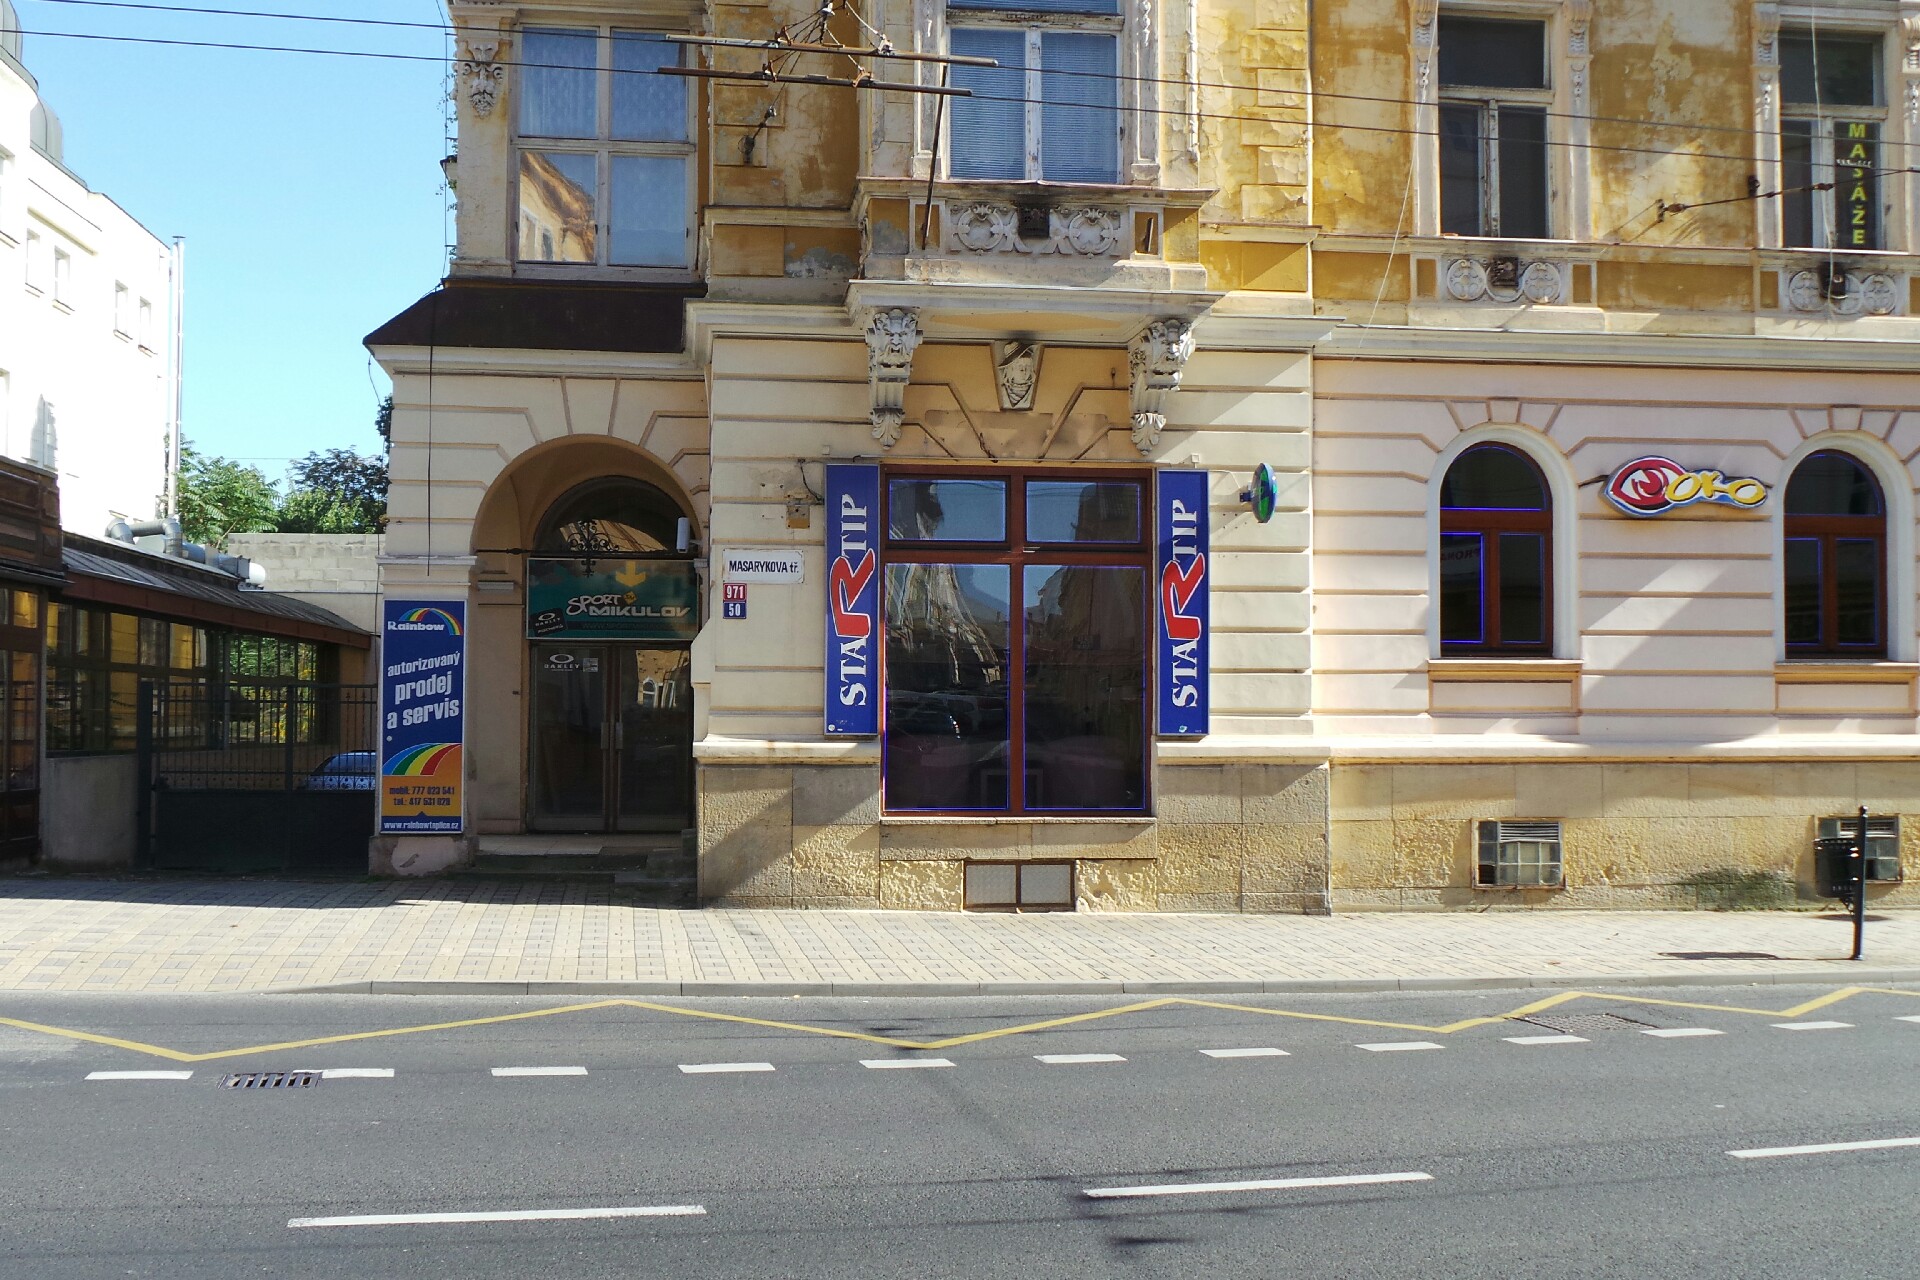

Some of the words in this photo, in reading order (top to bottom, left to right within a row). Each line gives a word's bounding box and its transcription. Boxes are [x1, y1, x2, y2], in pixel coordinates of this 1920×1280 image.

[729, 560, 788, 573] MASARYKOVA
[789, 562, 799, 573] tř.
[726, 585, 744, 599] 971
[566, 595, 621, 616] SPORT
[588, 606, 690, 617] MIKULOV
[728, 603, 741, 617] 50
[387, 621, 445, 631] Rainbow
[387, 650, 460, 677] autorizovaný
[395, 670, 452, 705] prodej
[387, 711, 398, 730] a
[402, 697, 460, 726] servis
[412, 786, 425, 795] 777
[408, 797, 421, 805] 417
